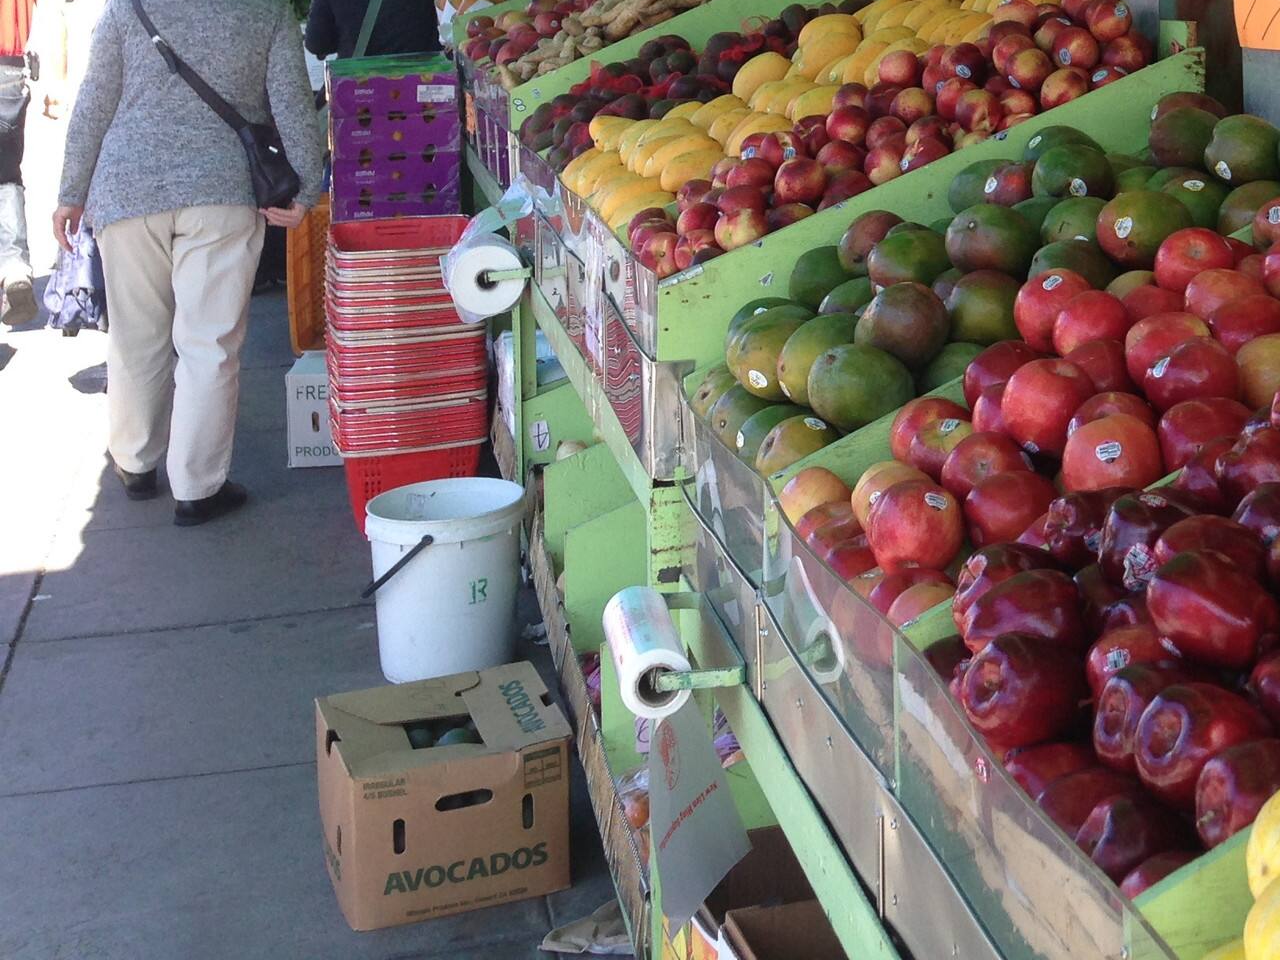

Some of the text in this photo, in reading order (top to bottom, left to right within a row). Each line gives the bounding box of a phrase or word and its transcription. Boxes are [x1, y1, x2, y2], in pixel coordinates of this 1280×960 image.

[296, 384, 327, 401] FRE
[295, 446, 339, 457] PRODU
[384, 842, 549, 896] AVOCADOS
